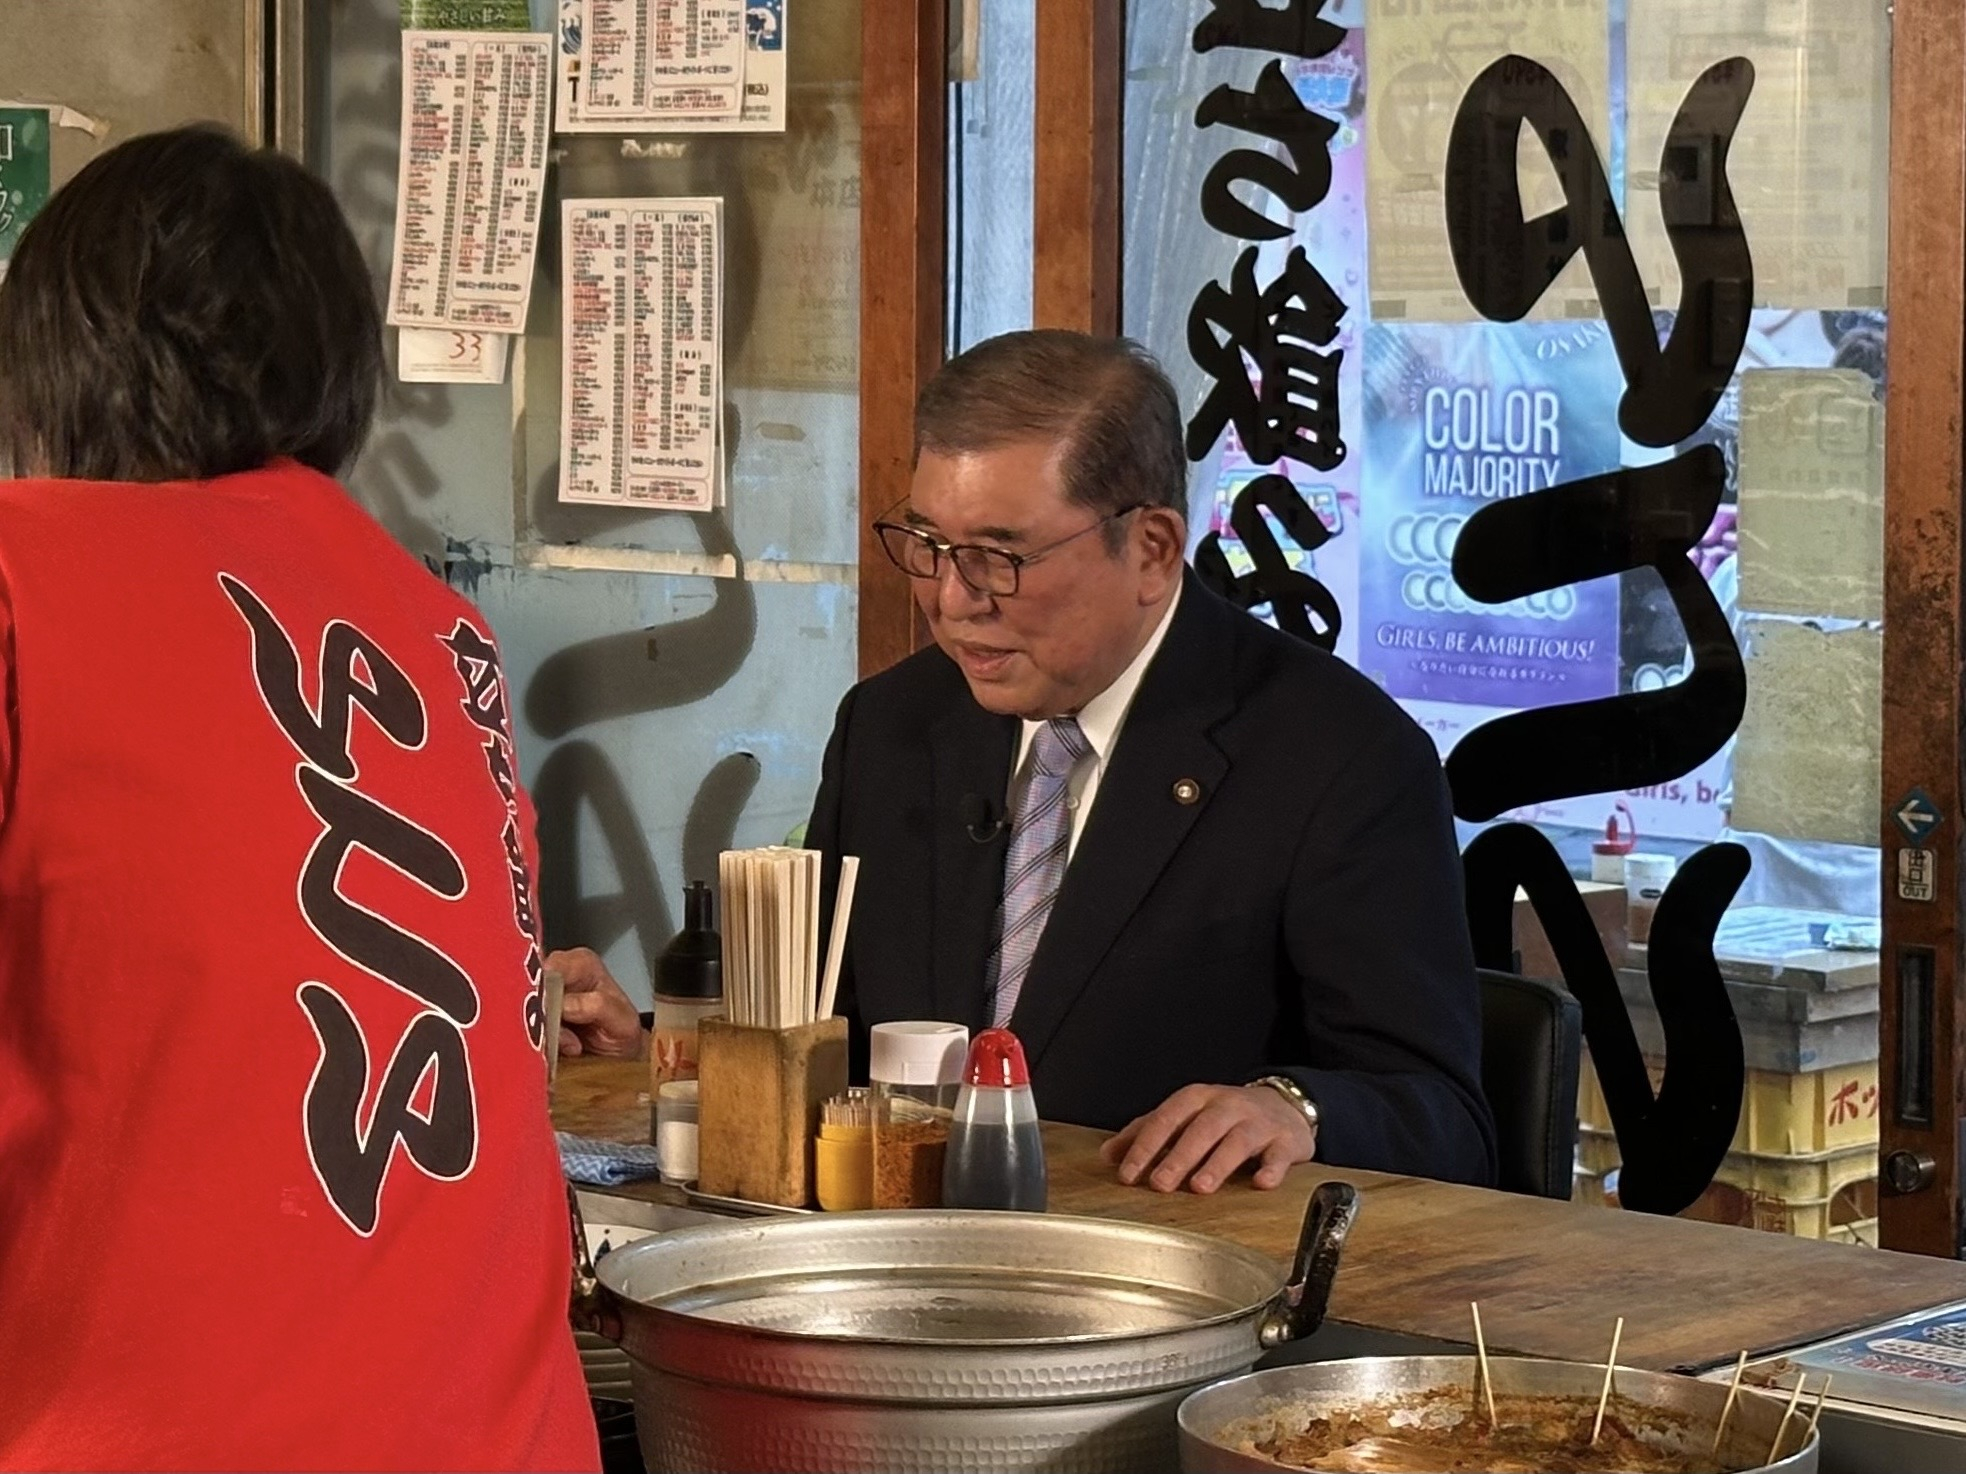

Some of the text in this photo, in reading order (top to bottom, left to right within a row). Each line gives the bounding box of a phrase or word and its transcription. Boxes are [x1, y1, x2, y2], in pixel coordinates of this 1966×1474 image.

[1424, 386, 1560, 456] COLOR
[1424, 453, 1560, 498] MAJORITY
[1445, 631, 1467, 652] BE
[1470, 635, 1595, 662] AMBITIOUS!
[1902, 885, 1927, 898] OUT
